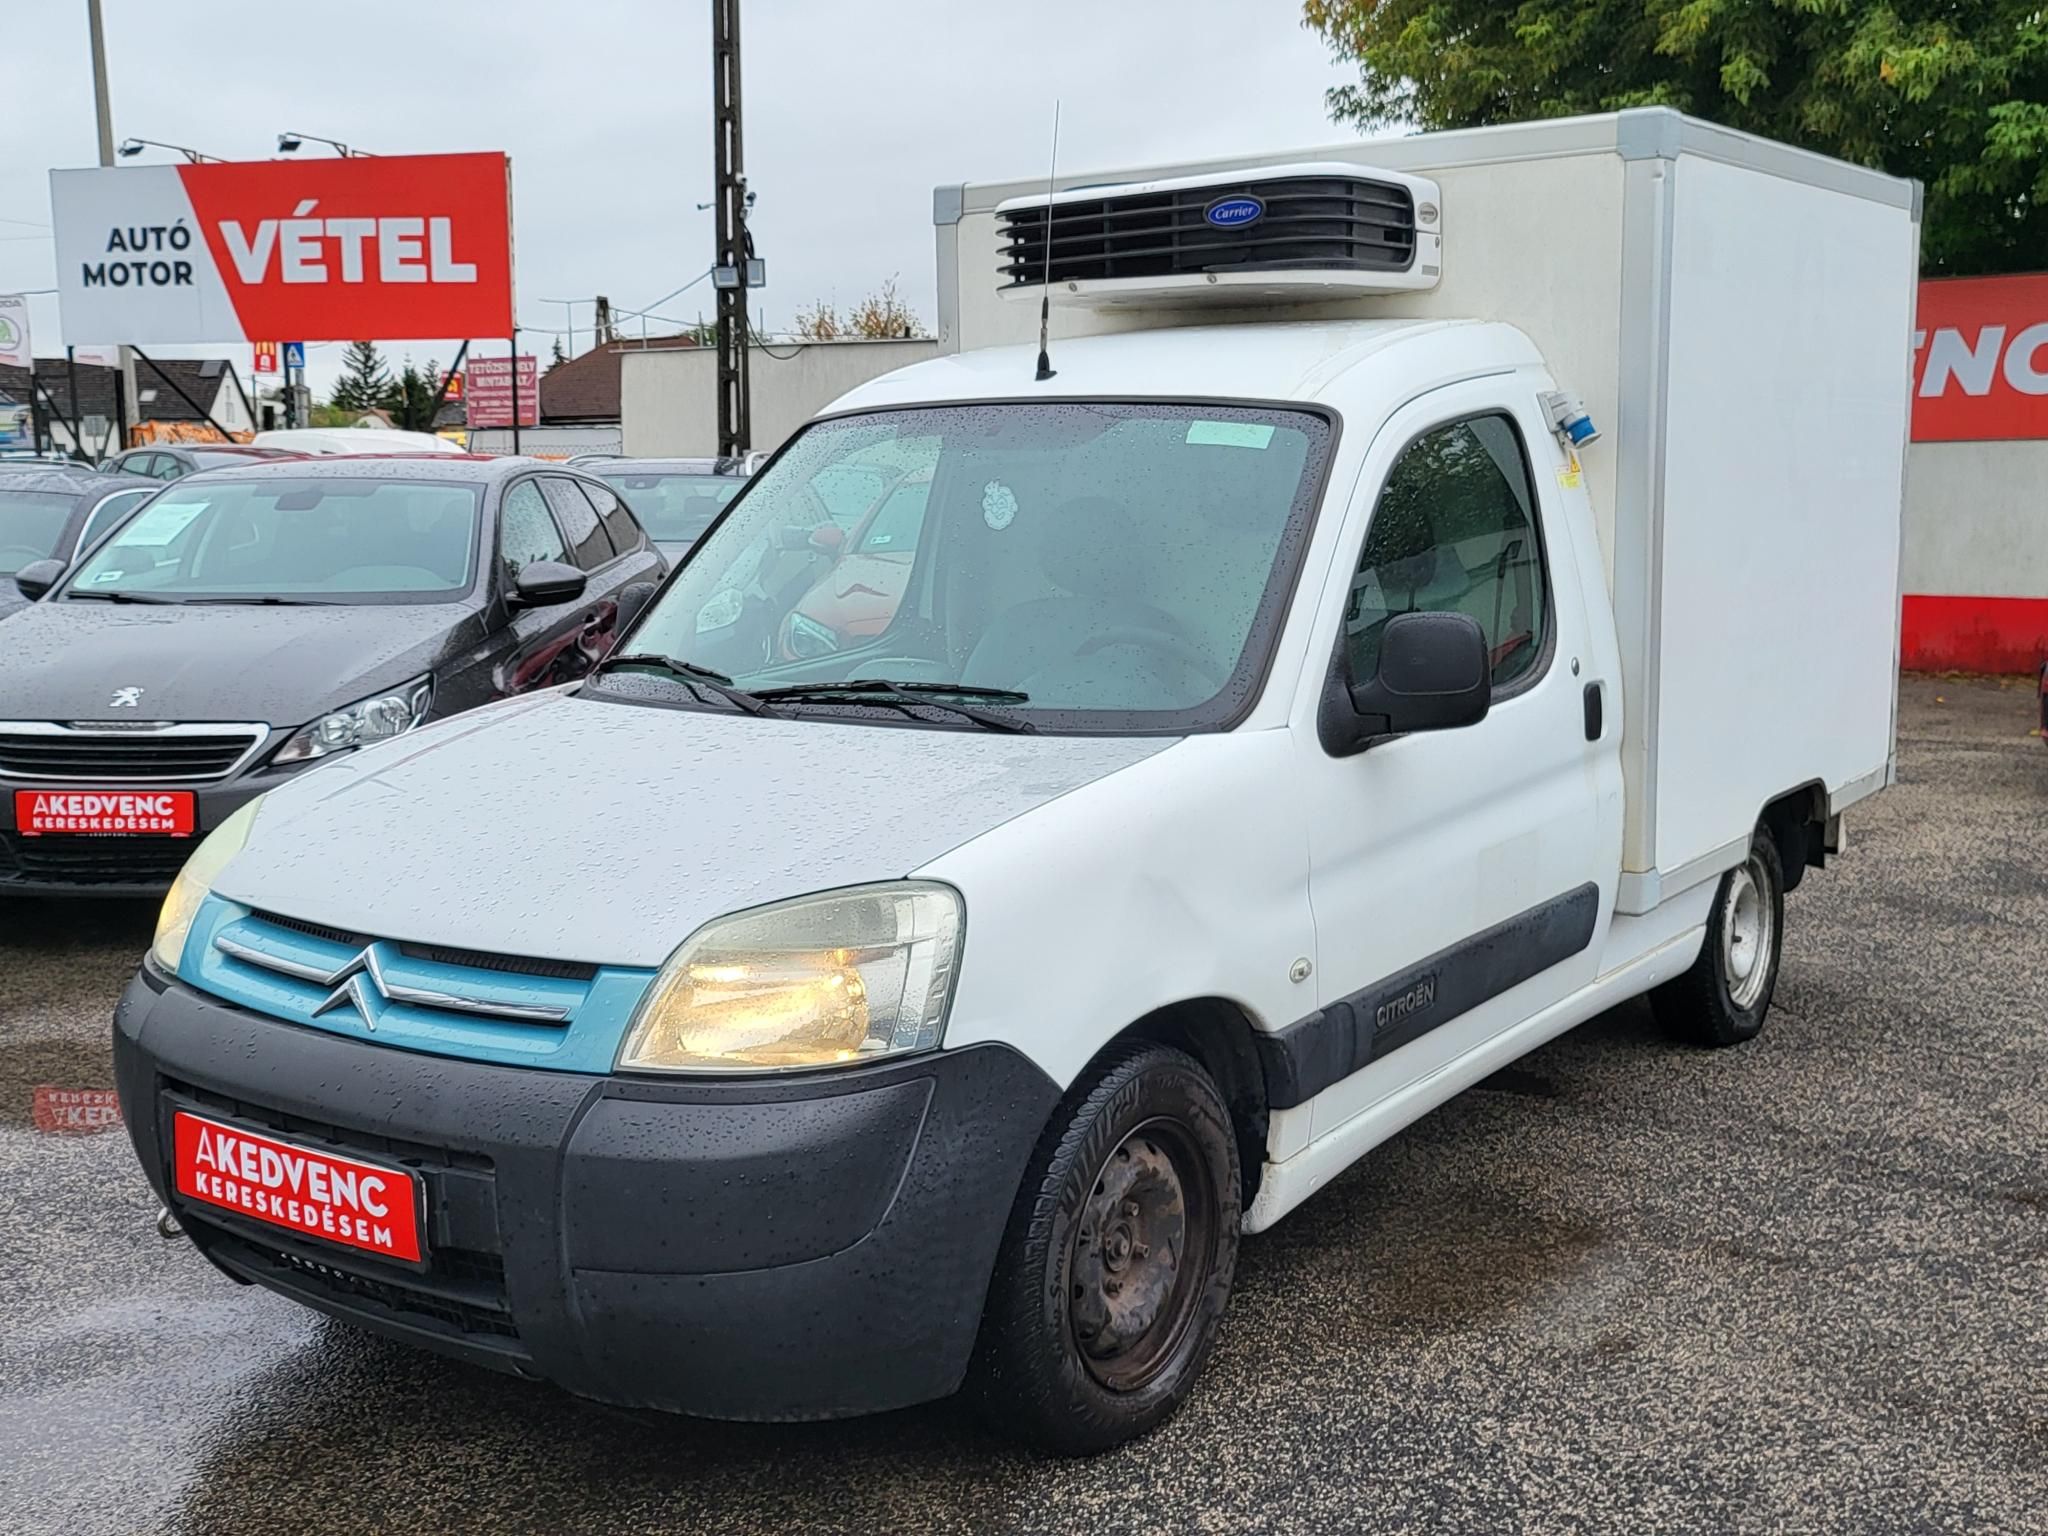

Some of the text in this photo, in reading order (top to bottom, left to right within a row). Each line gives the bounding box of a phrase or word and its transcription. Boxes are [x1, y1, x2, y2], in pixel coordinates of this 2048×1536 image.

[1214, 206, 1255, 220] Carrier
[106, 218, 191, 253] AUTÓ
[217, 199, 478, 284] VÉTEL
[82, 261, 194, 287] MOTOR
[32, 816, 175, 830] KERESKEDÉSEM
[1376, 981, 1435, 1028] CITROËN
[195, 1170, 393, 1249] KERESKEDÉSEM
